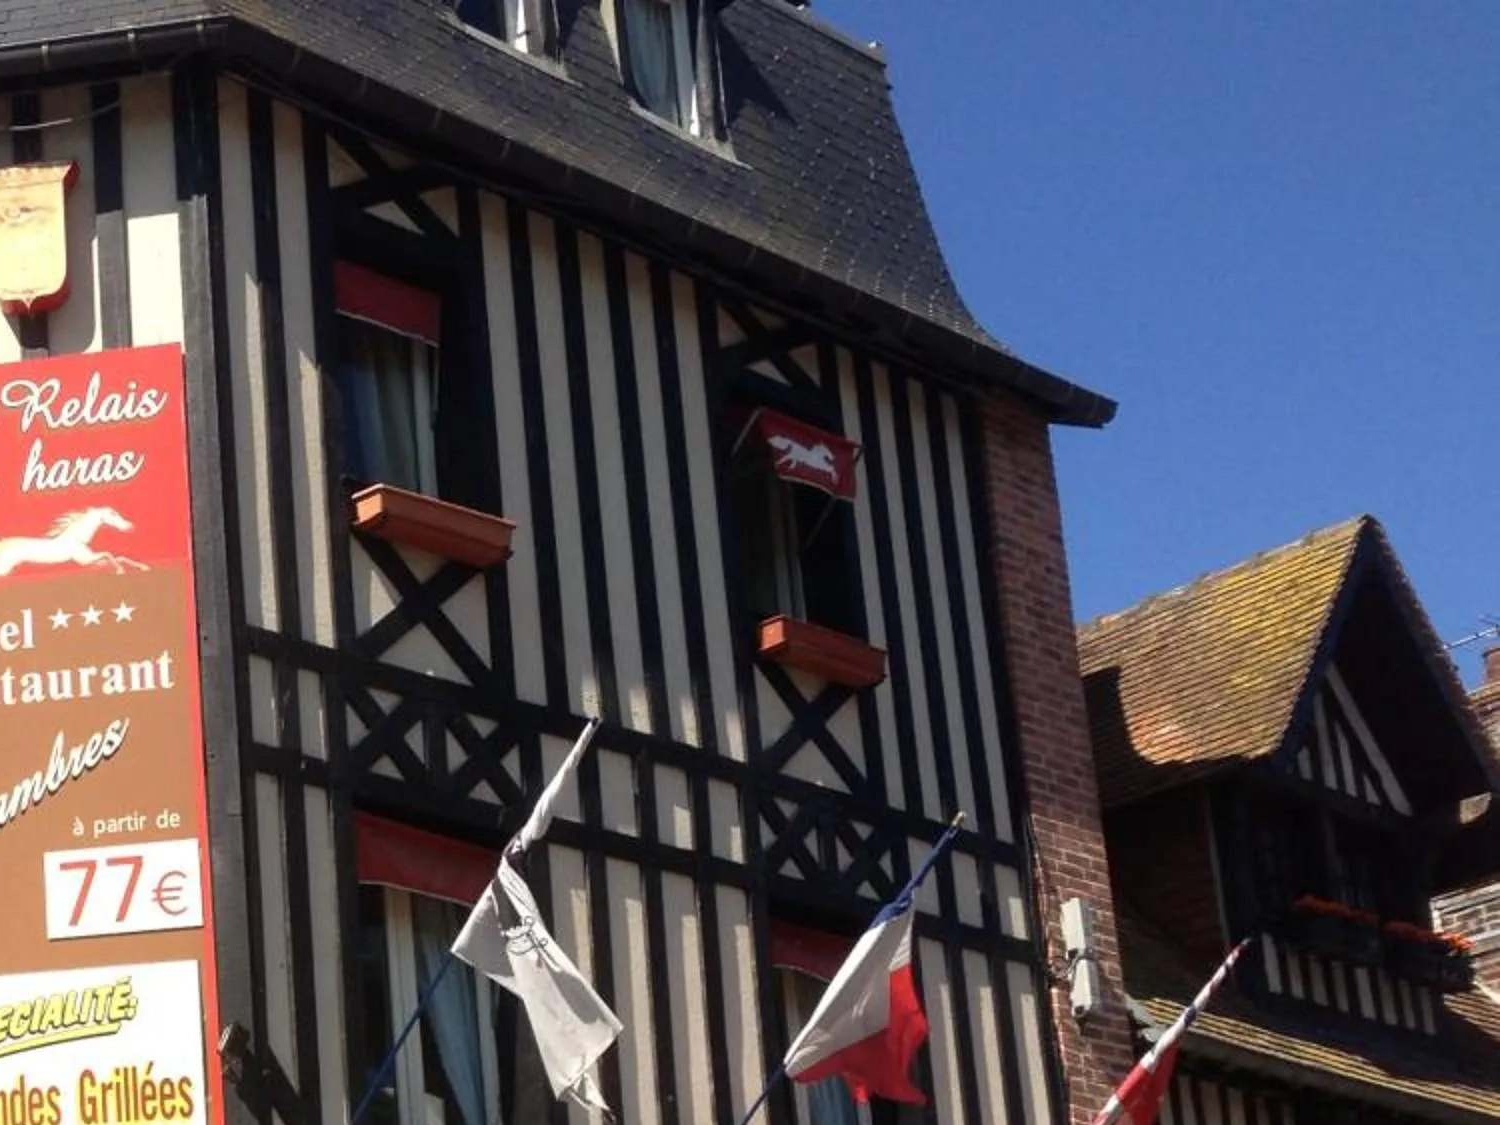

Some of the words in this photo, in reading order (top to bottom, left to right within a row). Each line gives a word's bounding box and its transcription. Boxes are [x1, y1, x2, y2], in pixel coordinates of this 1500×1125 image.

[1, 371, 169, 433] Relais
[21, 437, 145, 492] haras
[72, 816, 85, 836] à
[93, 810, 147, 839] partir
[156, 808, 181, 829] de
[59, 855, 189, 927] 77€
[78, 1060, 194, 1125] Grillées
